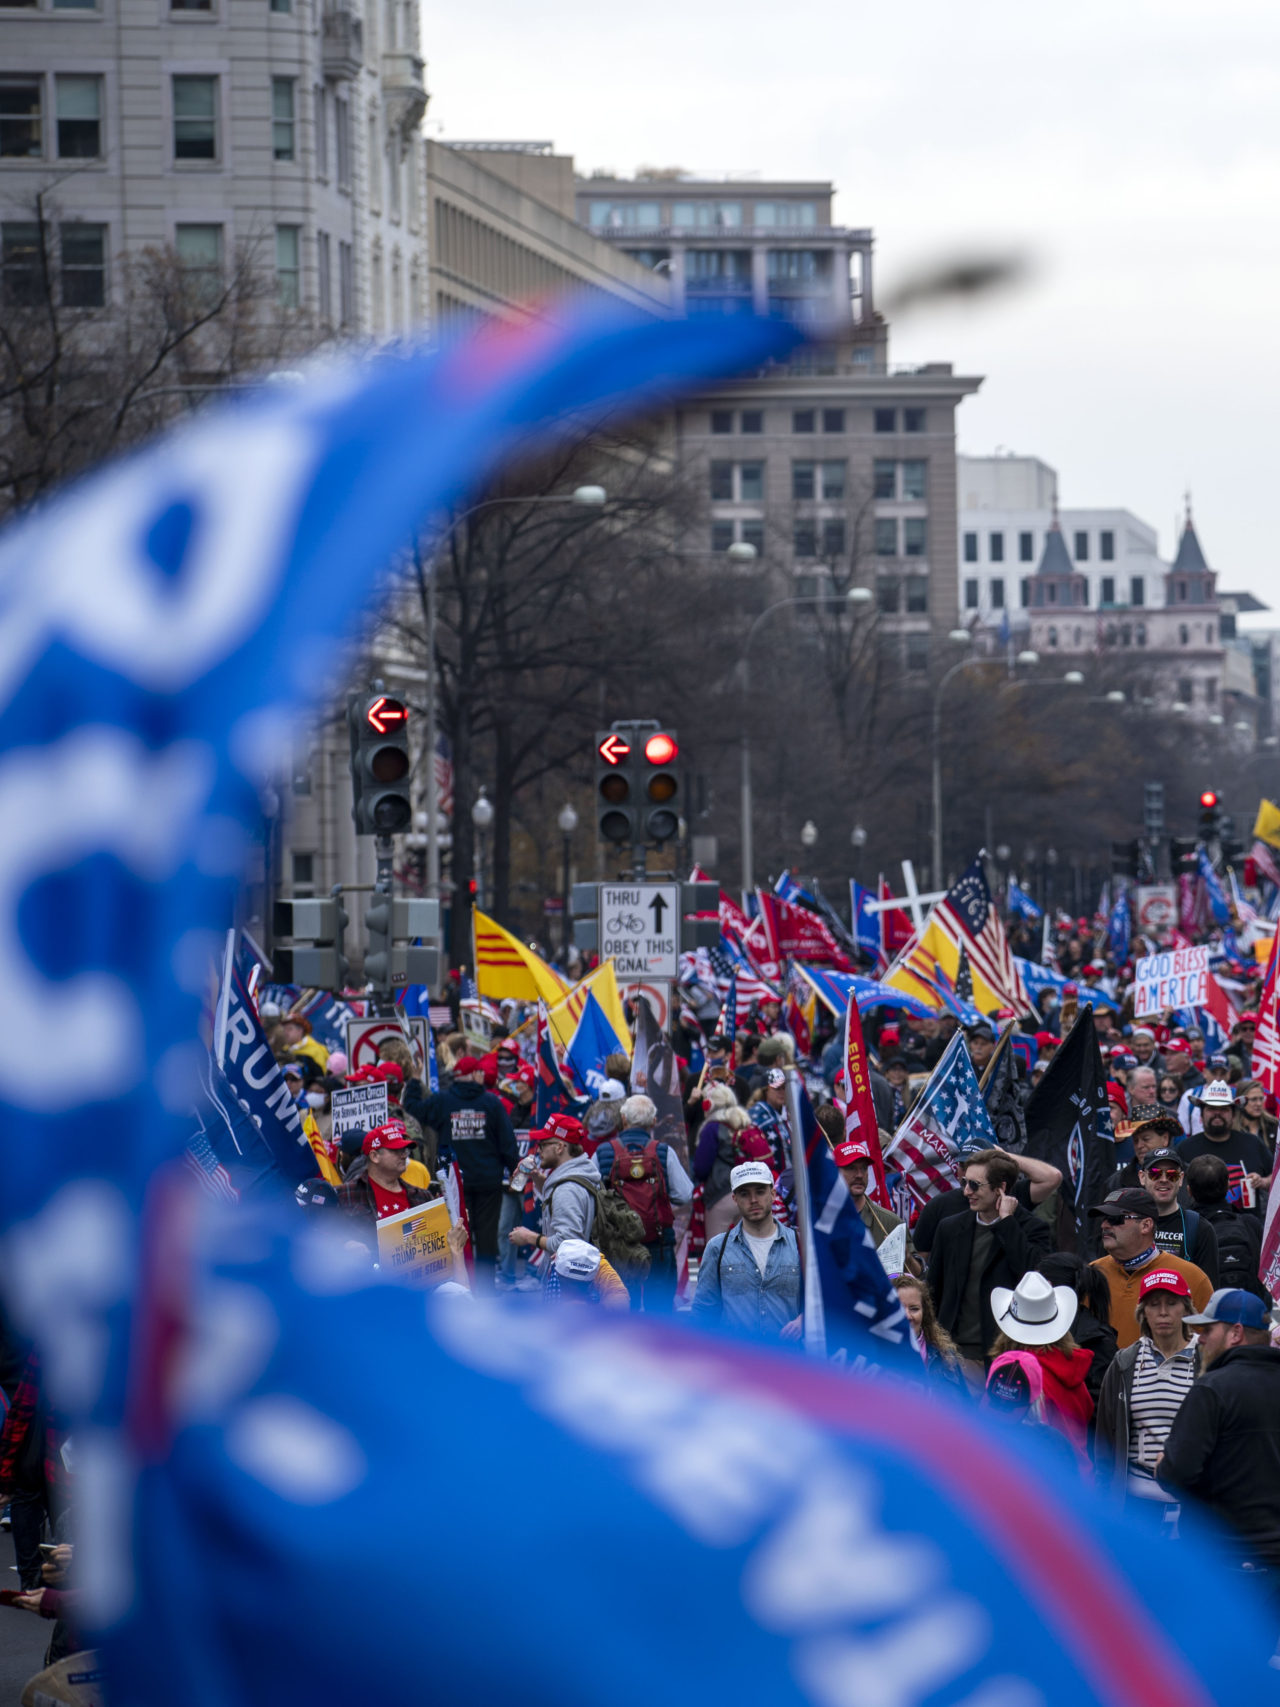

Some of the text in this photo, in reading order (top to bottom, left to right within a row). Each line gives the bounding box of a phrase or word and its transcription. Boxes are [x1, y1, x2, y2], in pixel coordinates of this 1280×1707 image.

[605, 890, 640, 906] THRU
[960, 886, 981, 915] 76
[604, 938, 674, 955] OBEY THIS
[606, 957, 653, 973] IGNAL
[1137, 947, 1207, 982] GOD BLESS
[1134, 970, 1209, 1015] AMERICA
[226, 987, 307, 1147] RUM
[333, 1091, 348, 1106] THANK
[351, 1087, 366, 1103] POLICE
[366, 1085, 386, 1099] OFFICER
[341, 1106, 357, 1118] SERVING
[362, 1101, 386, 1114] PROTECTING
[333, 1121, 350, 1138] ALL
[354, 1119, 366, 1131] OF
[451, 1118, 486, 1129] TRUMP
[371, 1137, 381, 1149] 45
